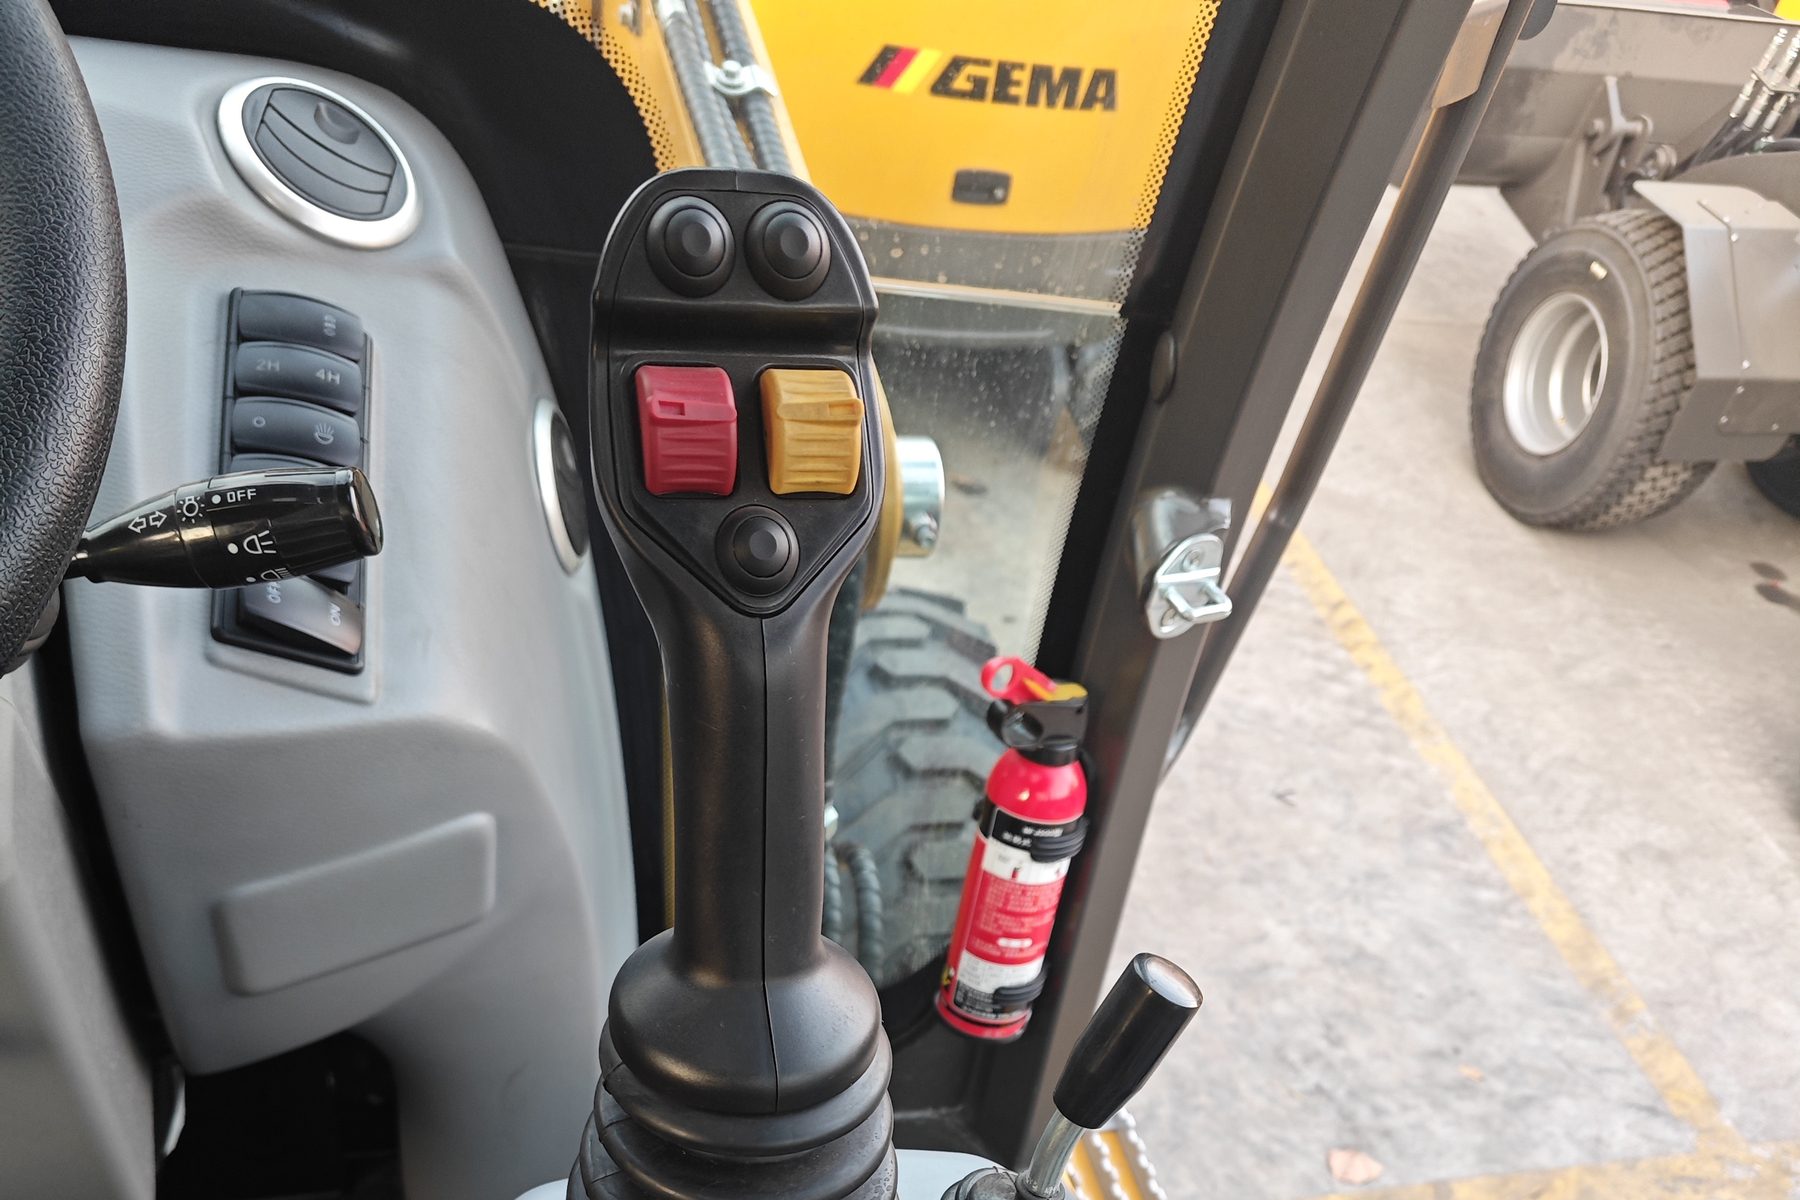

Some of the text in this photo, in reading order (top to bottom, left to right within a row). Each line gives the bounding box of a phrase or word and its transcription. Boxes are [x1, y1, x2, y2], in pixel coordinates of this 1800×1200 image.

[930, 55, 1117, 111] GEMA
[256, 358, 280, 371] 2H
[315, 368, 341, 384] 4H
[227, 489, 256, 503] OFF
[329, 603, 341, 626] ON
